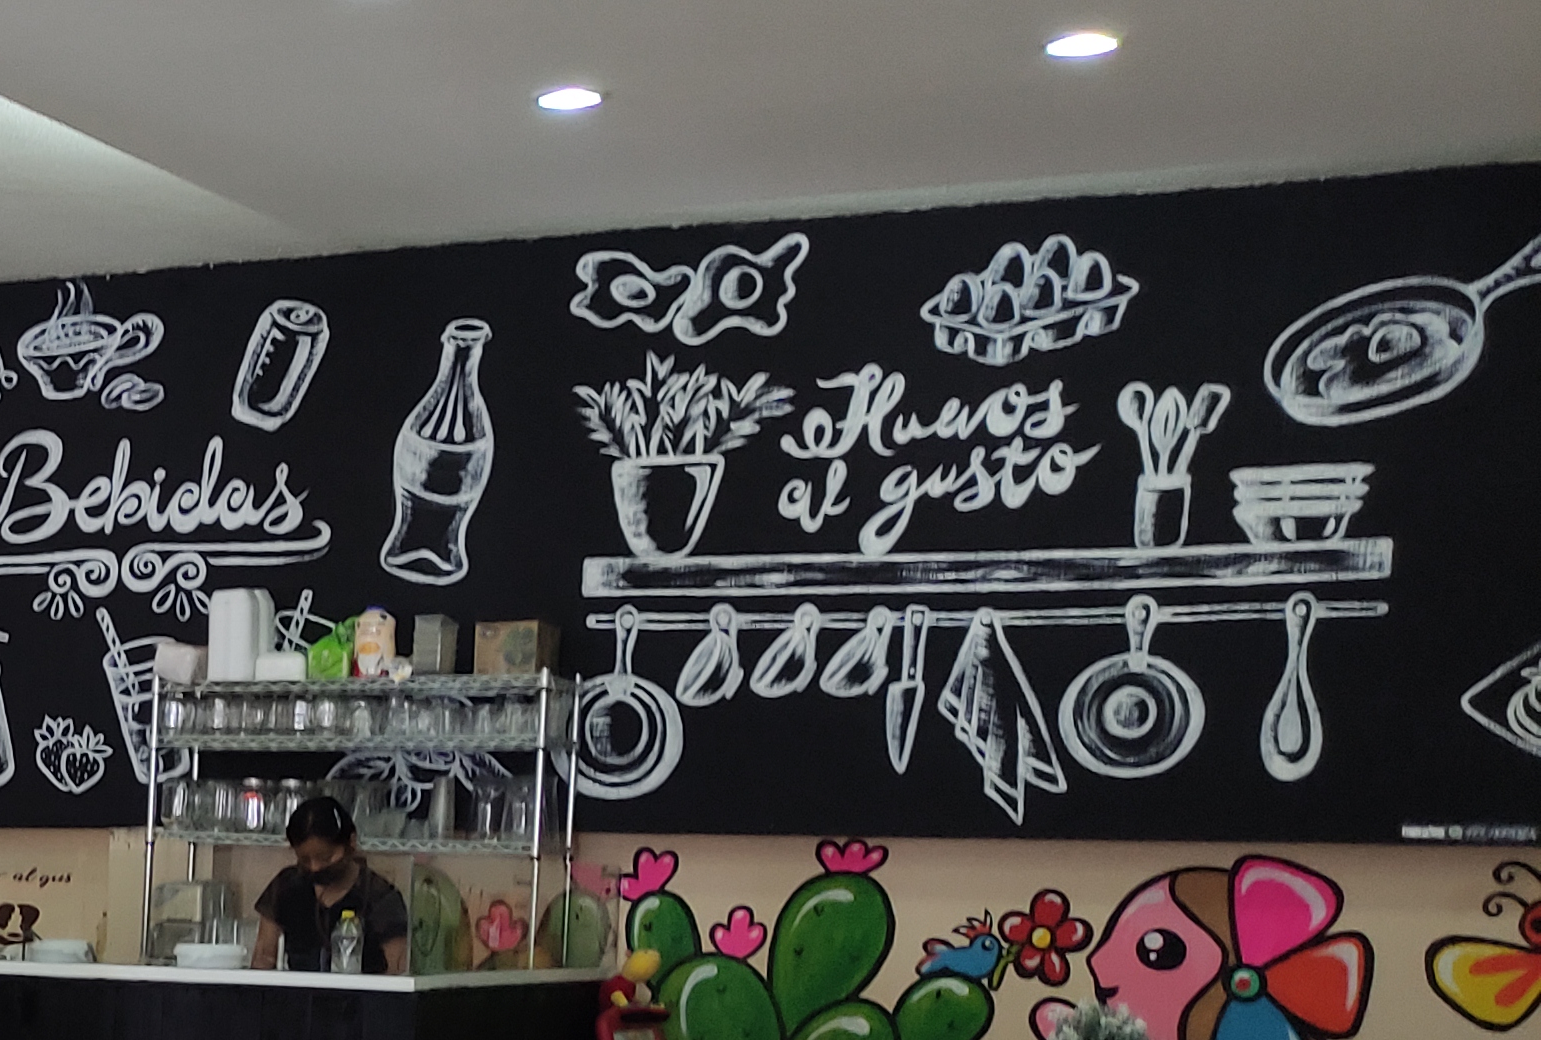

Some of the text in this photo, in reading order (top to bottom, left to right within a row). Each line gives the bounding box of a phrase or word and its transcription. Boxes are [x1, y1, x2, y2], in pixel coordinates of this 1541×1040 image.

[780, 362, 1080, 460] Huevos
[778, 436, 1102, 556] al gusto
[13, 866, 38, 884] al
